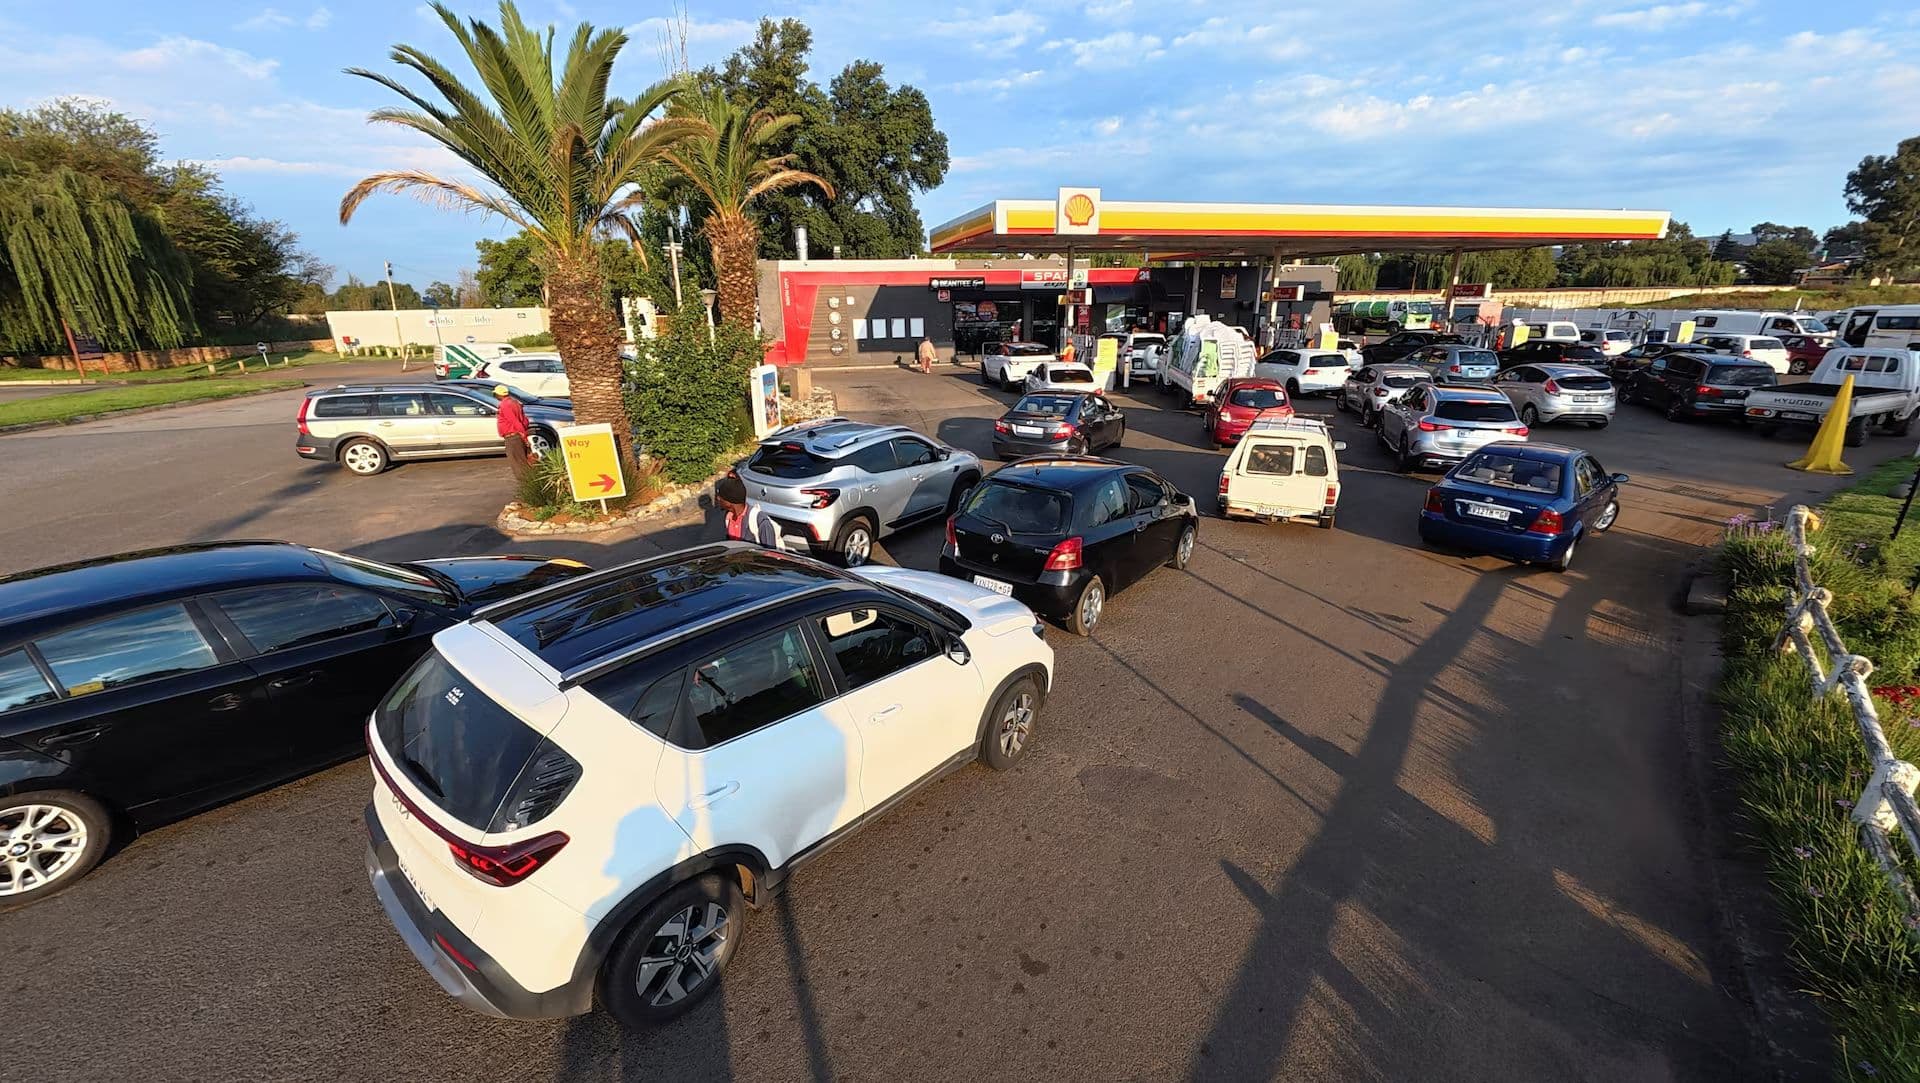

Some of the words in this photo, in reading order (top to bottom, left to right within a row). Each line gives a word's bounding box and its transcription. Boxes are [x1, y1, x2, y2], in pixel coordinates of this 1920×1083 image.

[1774, 398, 1824, 407] HYUNDAI
[567, 439, 590, 448] Way
[569, 451, 580, 459] In
